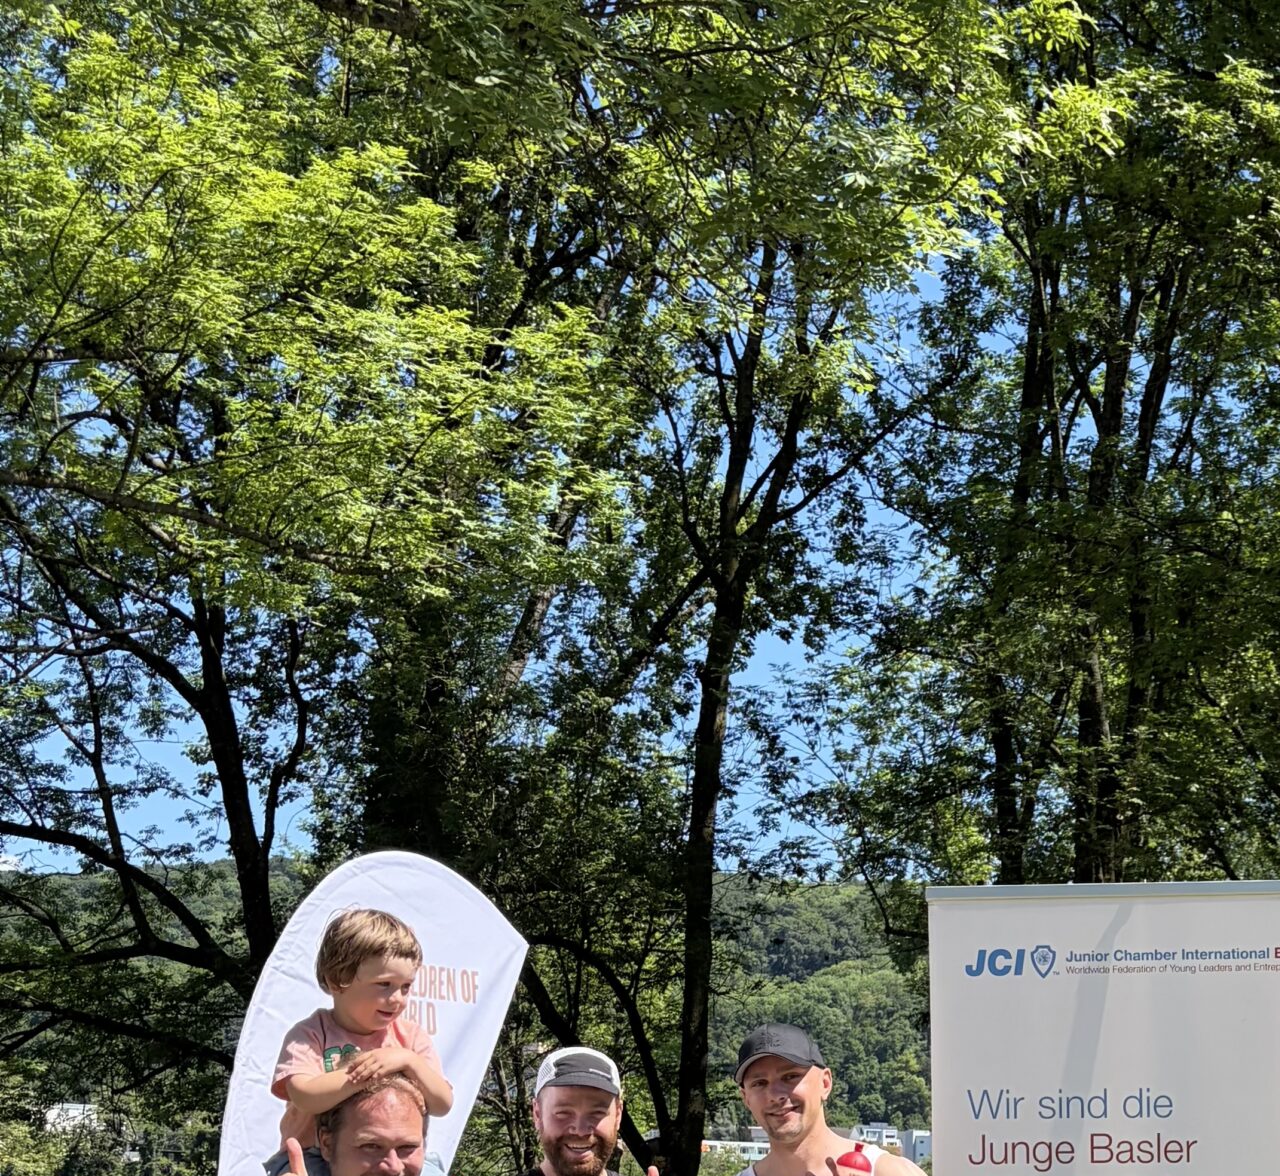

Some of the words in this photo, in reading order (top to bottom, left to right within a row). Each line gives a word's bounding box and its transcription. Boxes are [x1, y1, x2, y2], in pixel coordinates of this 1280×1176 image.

[965, 948, 1026, 977] JCI
[1065, 950, 1110, 963] Junior
[1113, 949, 1177, 962] Chamber
[1181, 948, 1270, 960] International
[1065, 965, 1110, 975] Worldwide
[1112, 964, 1156, 974] Federation
[1159, 964, 1168, 973] of
[1169, 964, 1197, 975] Young
[1198, 963, 1233, 972] Leaders
[1235, 963, 1251, 972] and
[461, 969, 479, 1004] OF
[967, 1088, 1025, 1120] Wir
[1038, 1088, 1108, 1120] sind
[1122, 1087, 1174, 1120] die
[968, 1134, 1076, 1172] Junge
[1089, 1132, 1199, 1165] Basler
